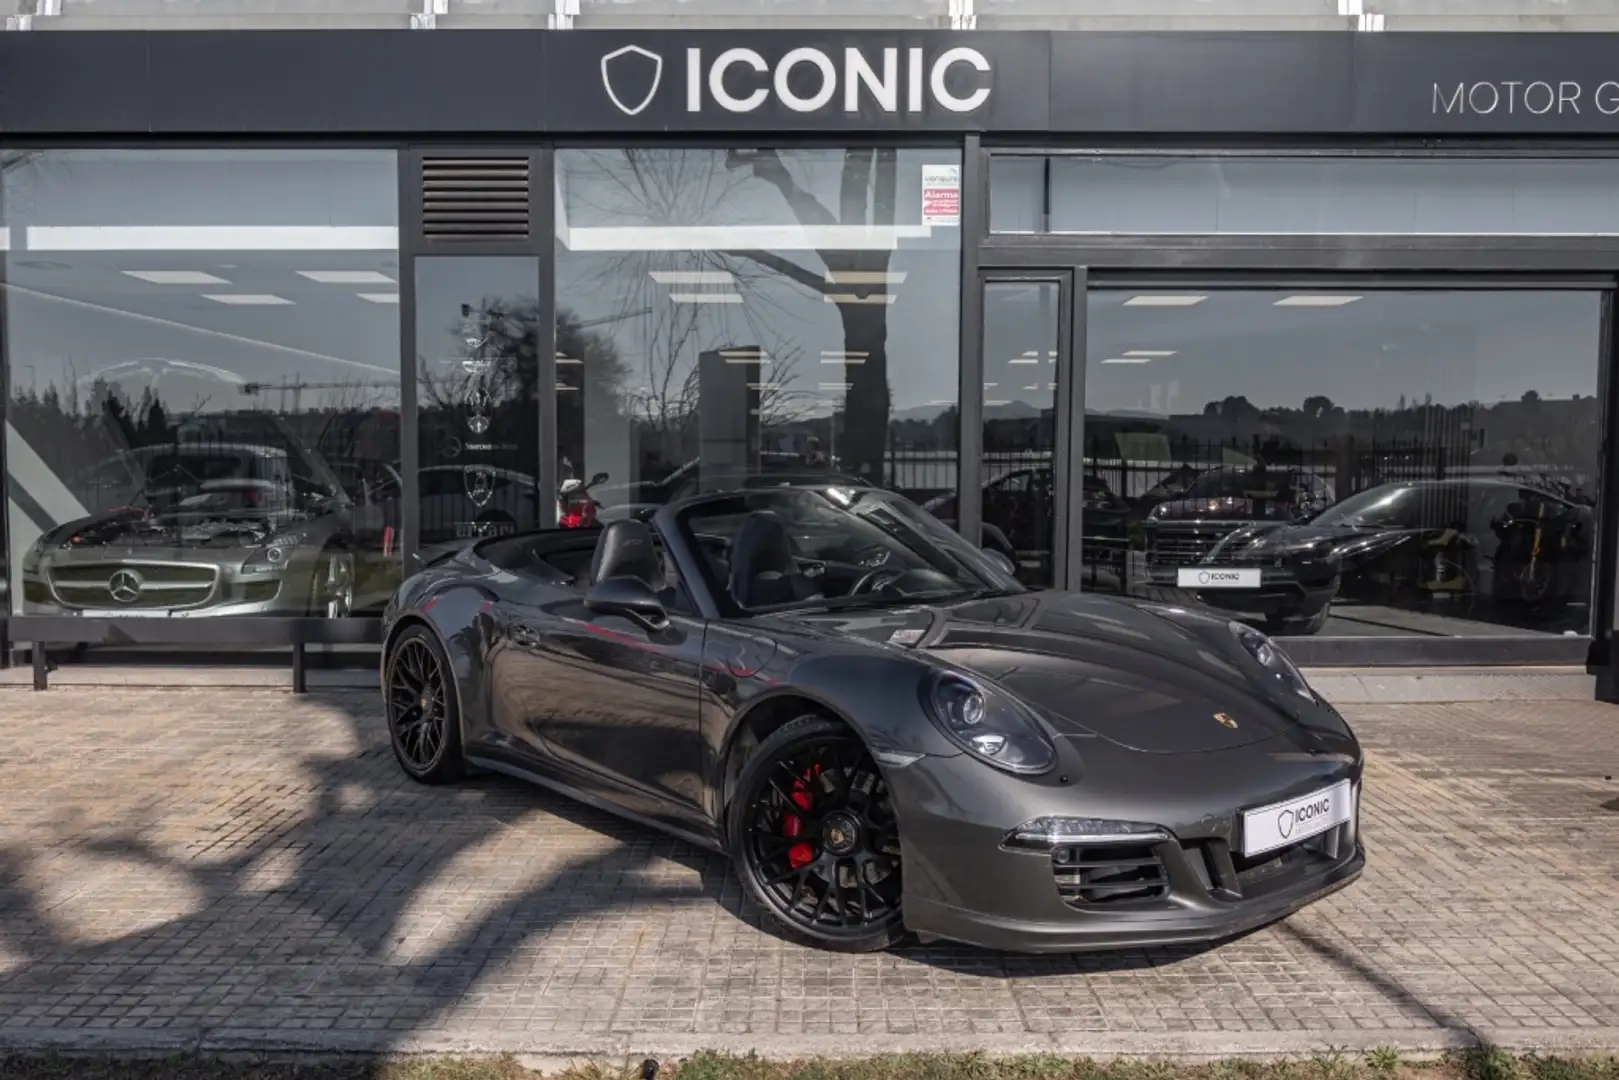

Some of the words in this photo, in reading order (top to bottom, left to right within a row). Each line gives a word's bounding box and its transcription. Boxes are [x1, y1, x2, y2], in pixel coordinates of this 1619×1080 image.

[687, 47, 991, 112] ICONIC
[1432, 81, 1581, 114] MOTOR
[1595, 81, 1619, 115] G
[925, 190, 959, 199] Alarma
[1211, 572, 1240, 580] ICONIC
[1295, 798, 1330, 823] ICONIC
